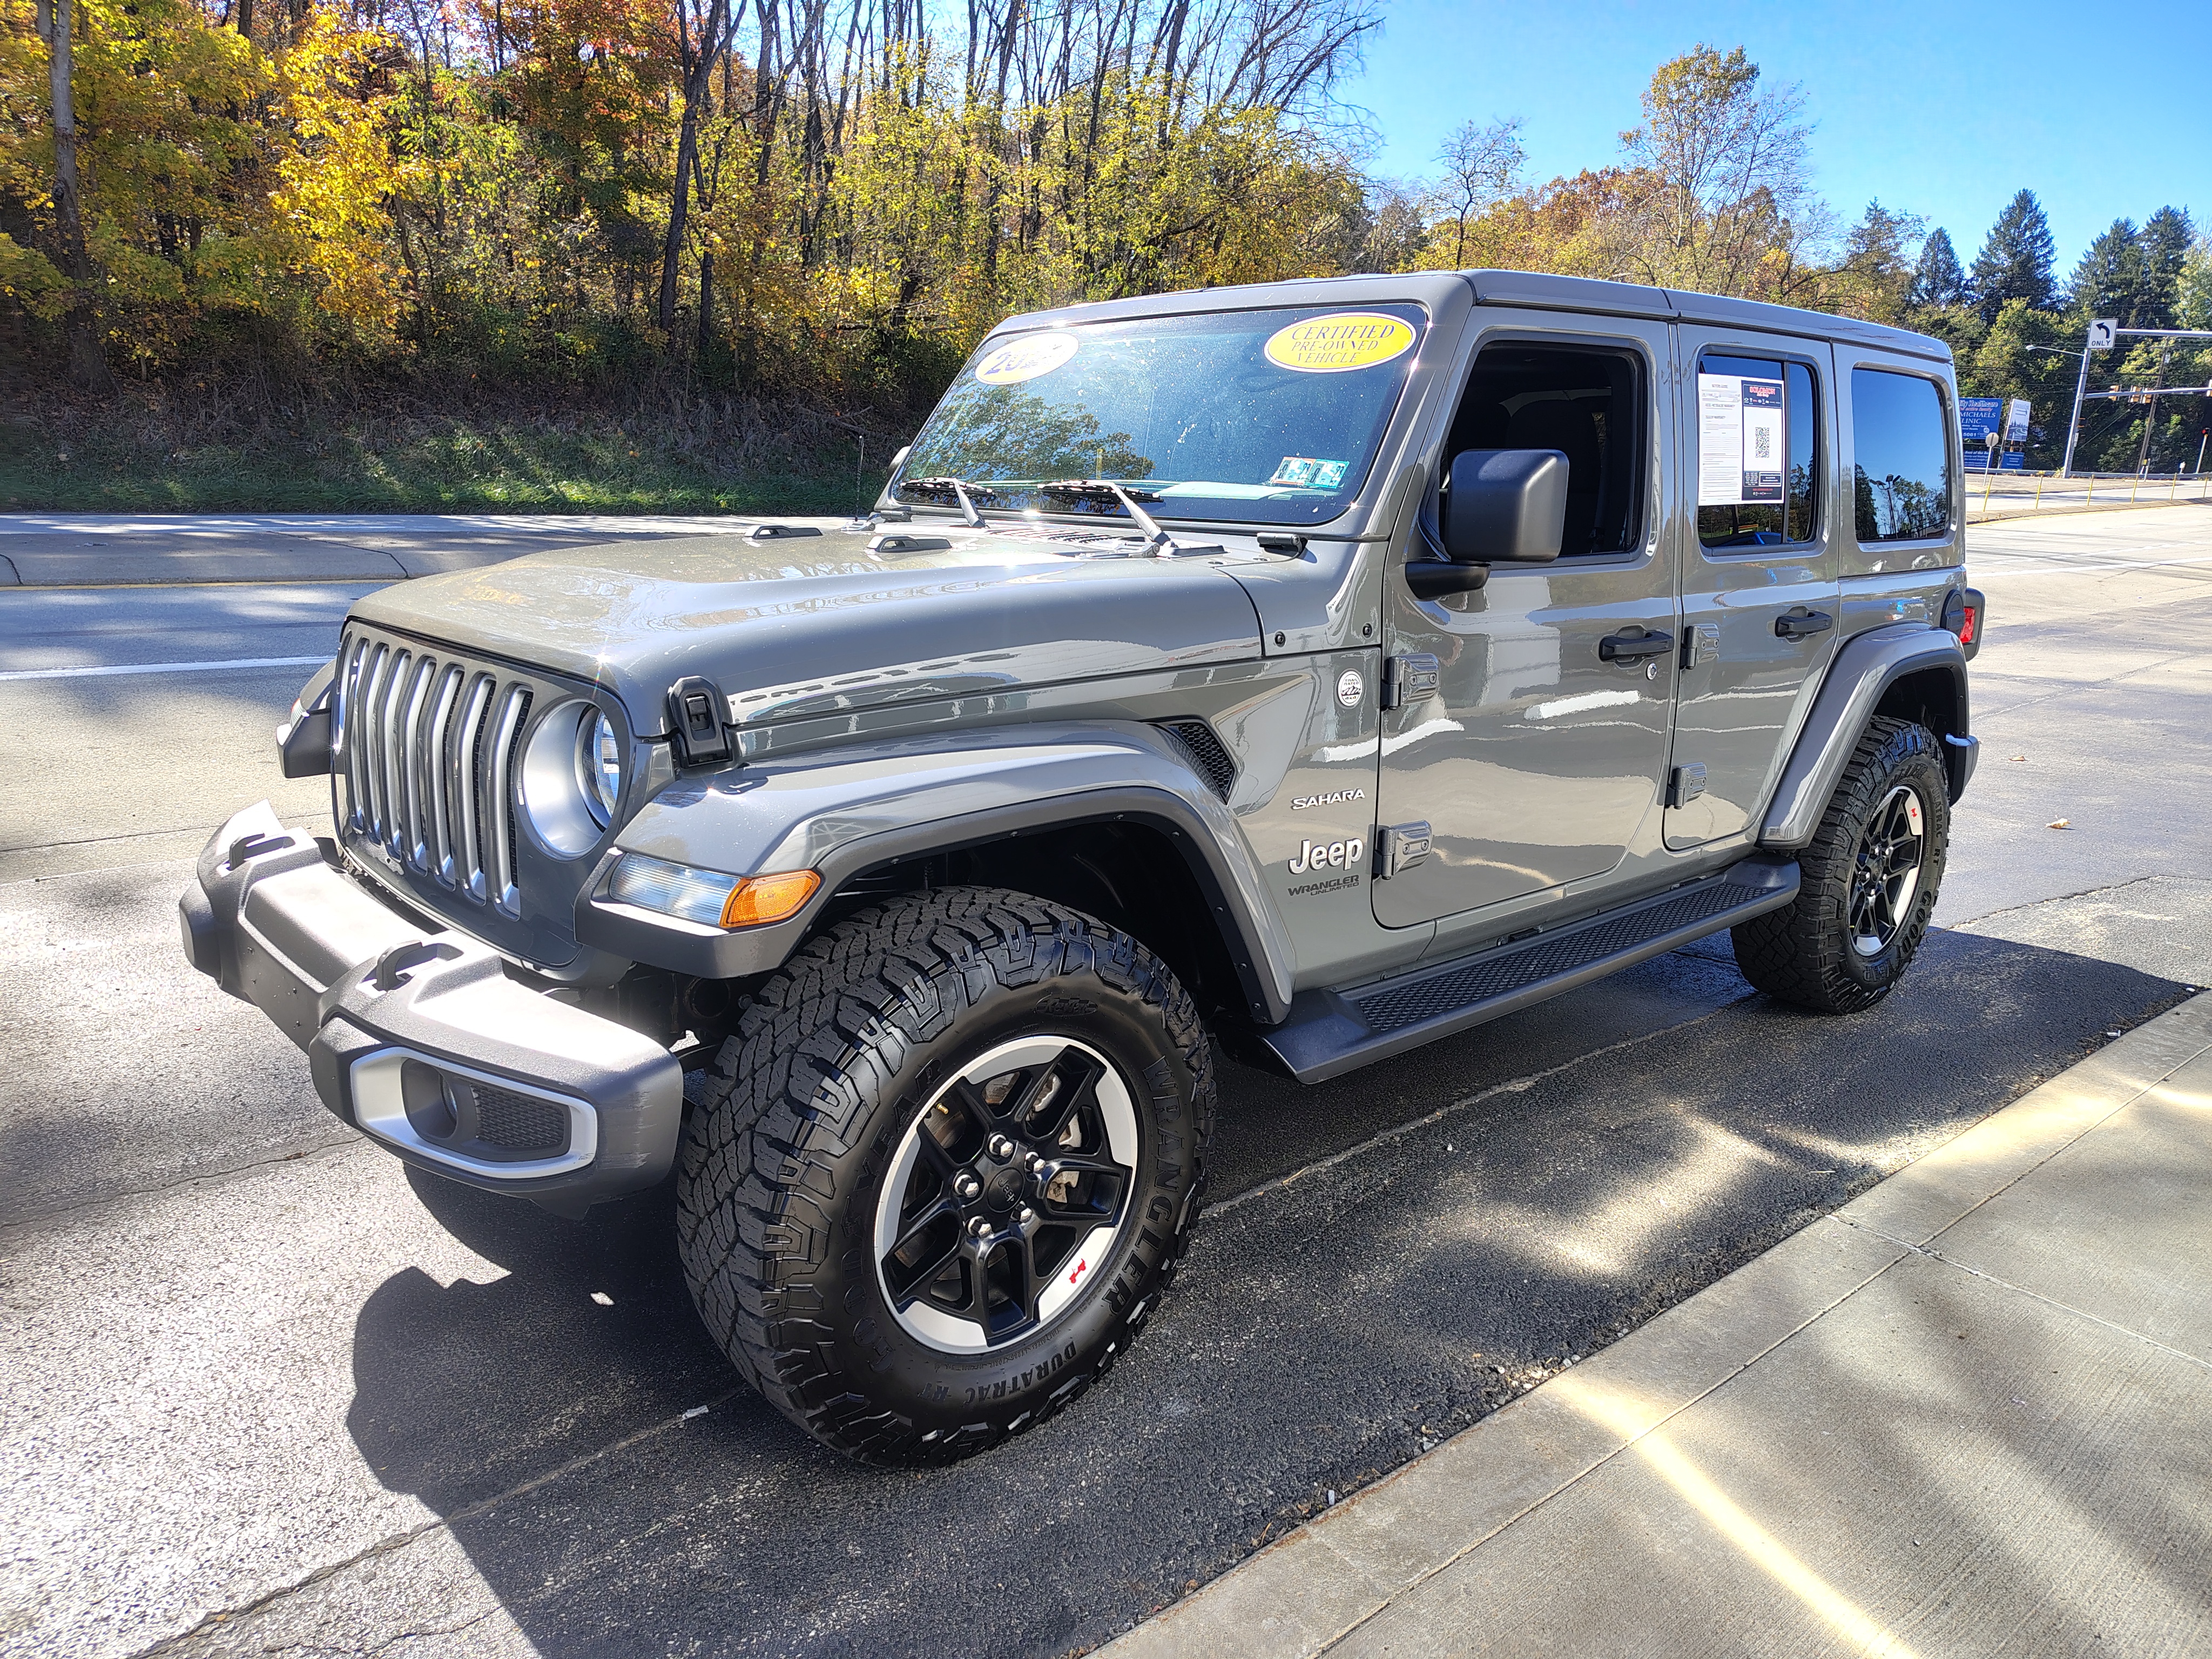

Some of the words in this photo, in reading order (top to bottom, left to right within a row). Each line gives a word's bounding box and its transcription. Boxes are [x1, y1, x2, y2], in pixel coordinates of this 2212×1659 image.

[1292, 325, 1395, 340] CERTIFIED
[1291, 340, 1378, 352] PRE-OWNED
[1297, 352, 1361, 363] VEHICLE
[1310, 468, 1321, 483] 8
[1290, 788, 1365, 810] SAHARA
[1288, 838, 1363, 874] Jeep
[1287, 874, 1359, 896] WRANGLER
[1311, 882, 1359, 896] UNLIMITED
[998, 1178, 1015, 1203] Jeep
[1102, 1056, 1183, 1315] WRANGLER
[963, 1340, 1077, 1405] DURATRAC
[918, 1382, 949, 1402] RT
